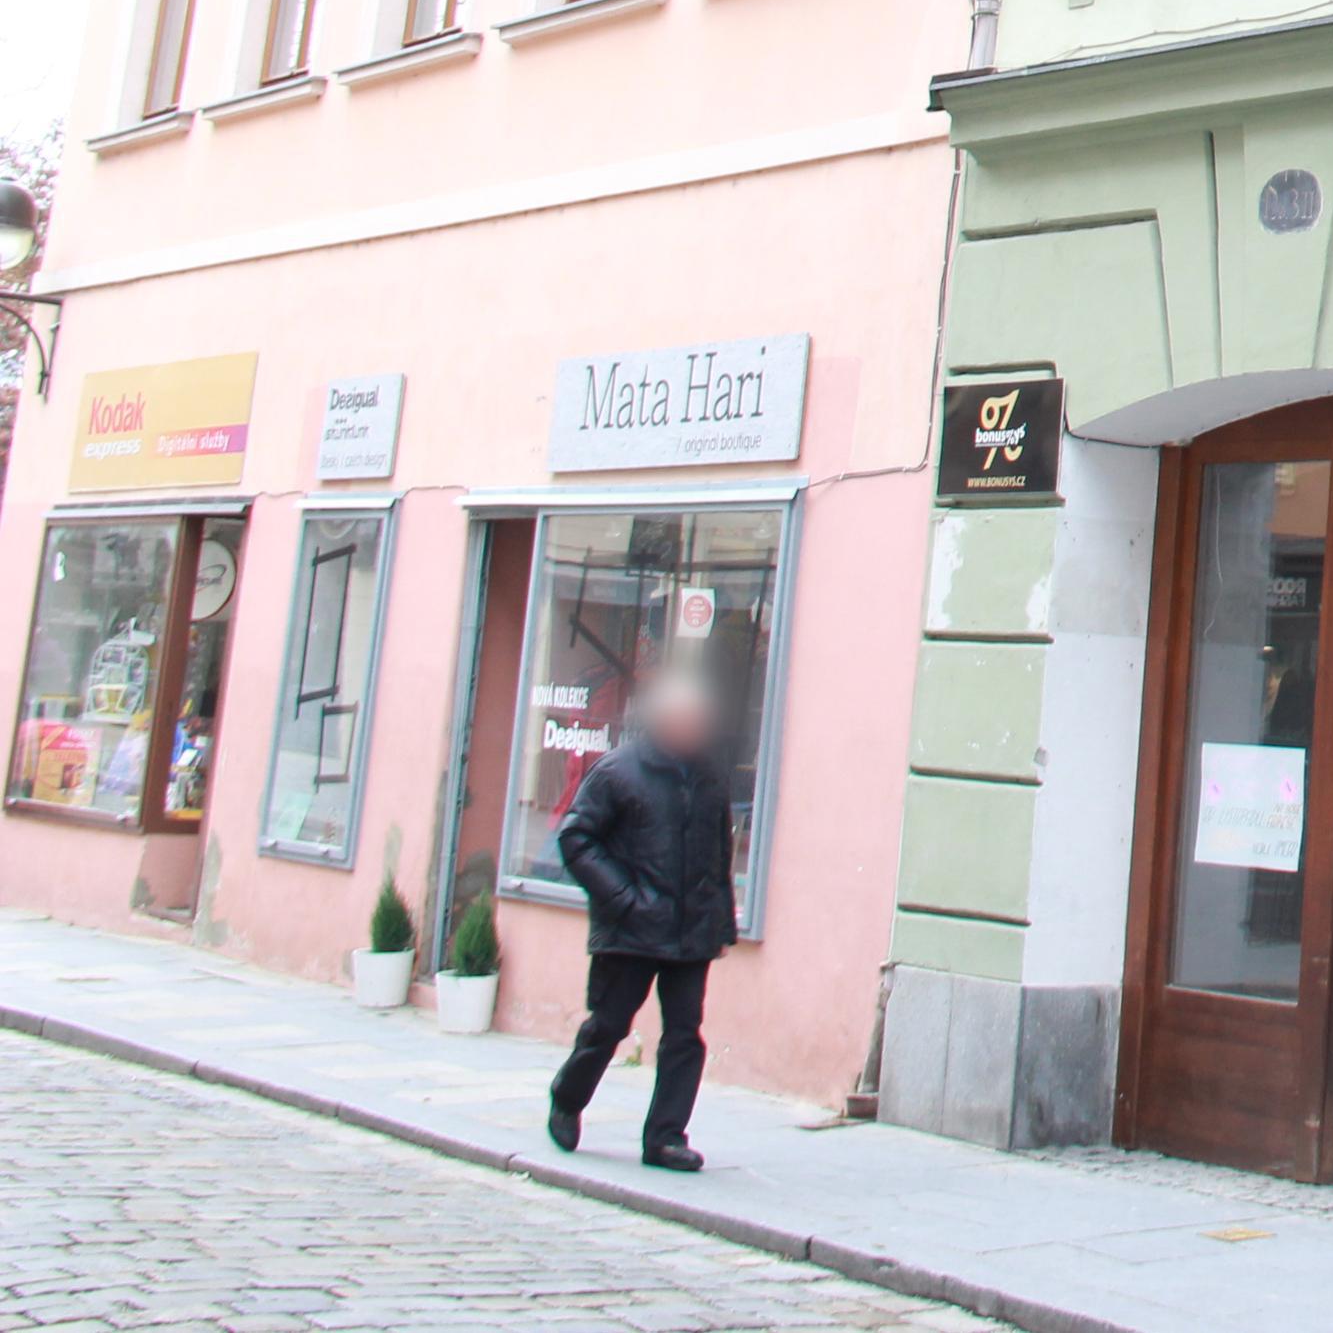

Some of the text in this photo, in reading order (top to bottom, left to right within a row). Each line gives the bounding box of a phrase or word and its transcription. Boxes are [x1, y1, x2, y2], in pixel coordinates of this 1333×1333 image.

[579, 345, 766, 431] Mata Hari
[88, 391, 146, 435] Kodak
[84, 438, 142, 460] express
[684, 434, 719, 457] original
[720, 433, 763, 453] boutique
[554, 684, 590, 710] KOLEKCE
